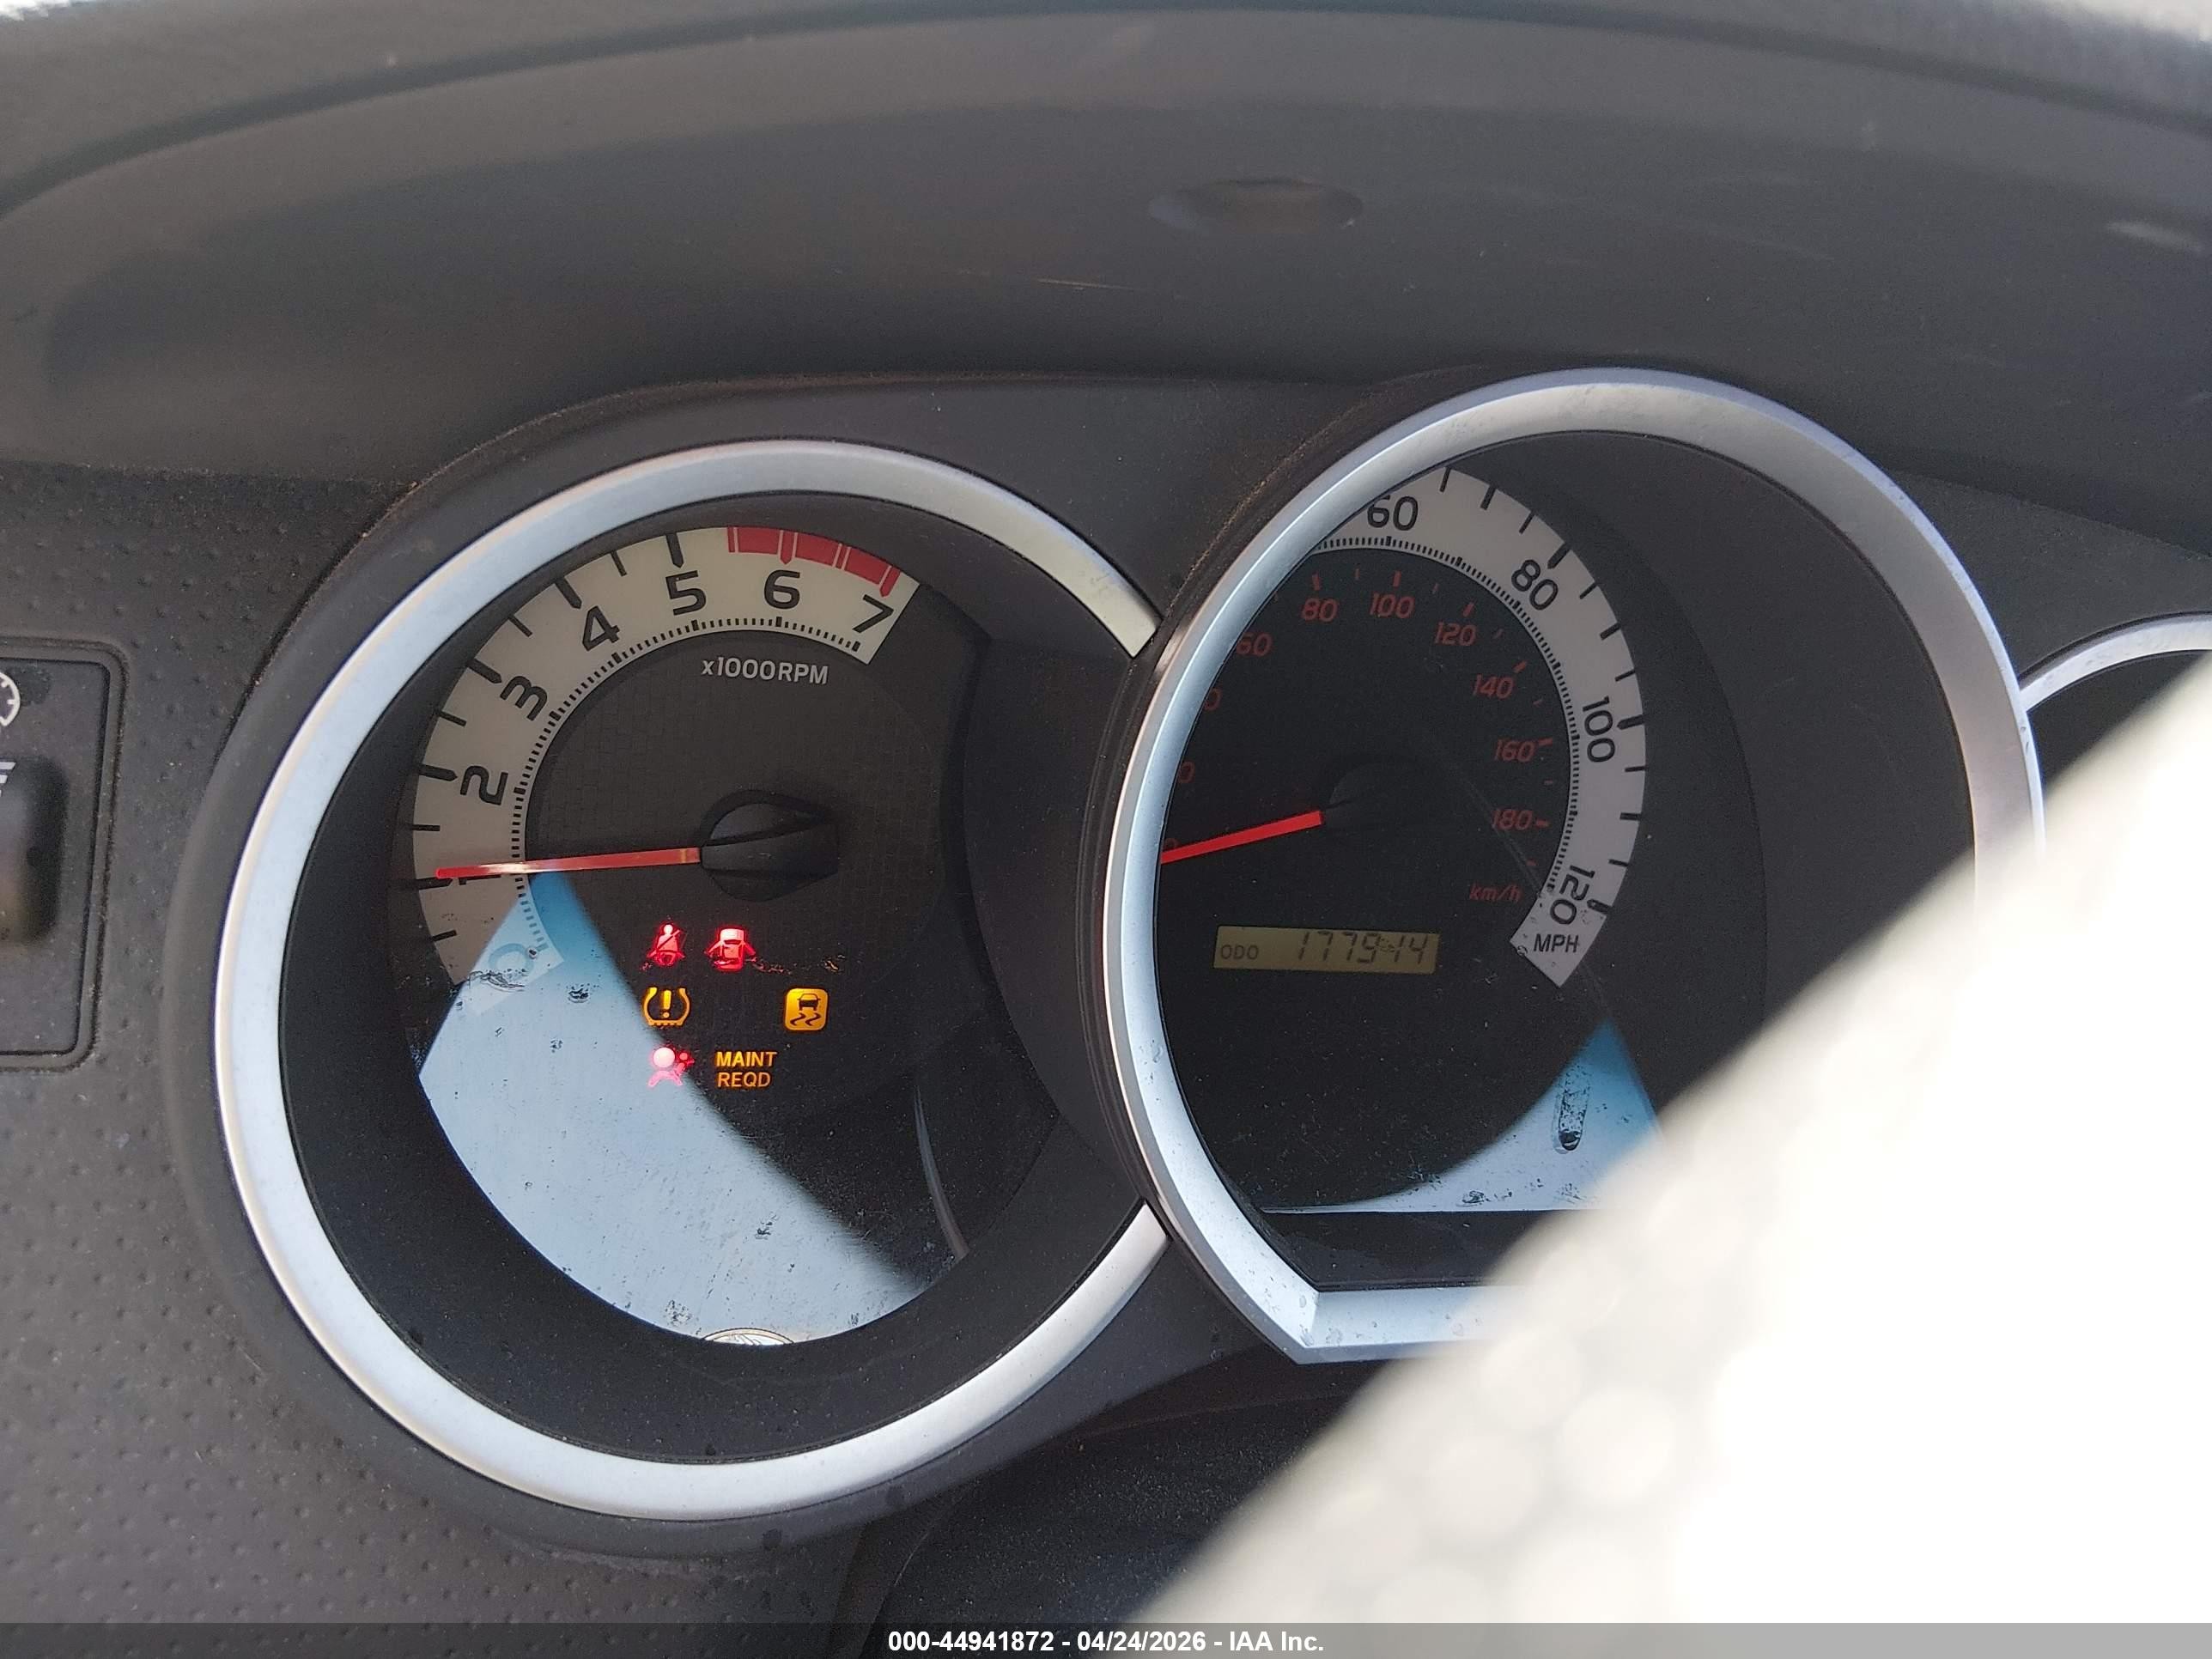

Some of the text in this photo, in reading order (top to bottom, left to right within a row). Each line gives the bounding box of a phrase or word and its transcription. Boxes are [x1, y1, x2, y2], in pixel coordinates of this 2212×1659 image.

[1367, 495, 1418, 531] 60
[665, 570, 707, 616] 5
[763, 570, 801, 610] 6
[1511, 559, 1559, 611] 80
[852, 594, 895, 635] 7
[1300, 597, 1339, 622] 80
[1369, 593, 1414, 620] 100
[581, 606, 620, 651] 4
[1434, 621, 1477, 647] 120
[1237, 632, 1273, 657] 60
[500, 673, 549, 720] 3
[1473, 672, 1516, 700] 140
[1582, 696, 1616, 763] 100
[1495, 740, 1534, 762] 160
[460, 764, 509, 805] 2
[1492, 809, 1533, 830] 180
[1469, 883, 1524, 903] km/h
[1550, 865, 1596, 925] 120
[1220, 930, 1428, 965] ODO 177914
[1534, 933, 1580, 953] MPH
[716, 1051, 777, 1066] MAINT
[717, 1072, 771, 1087] REQD
